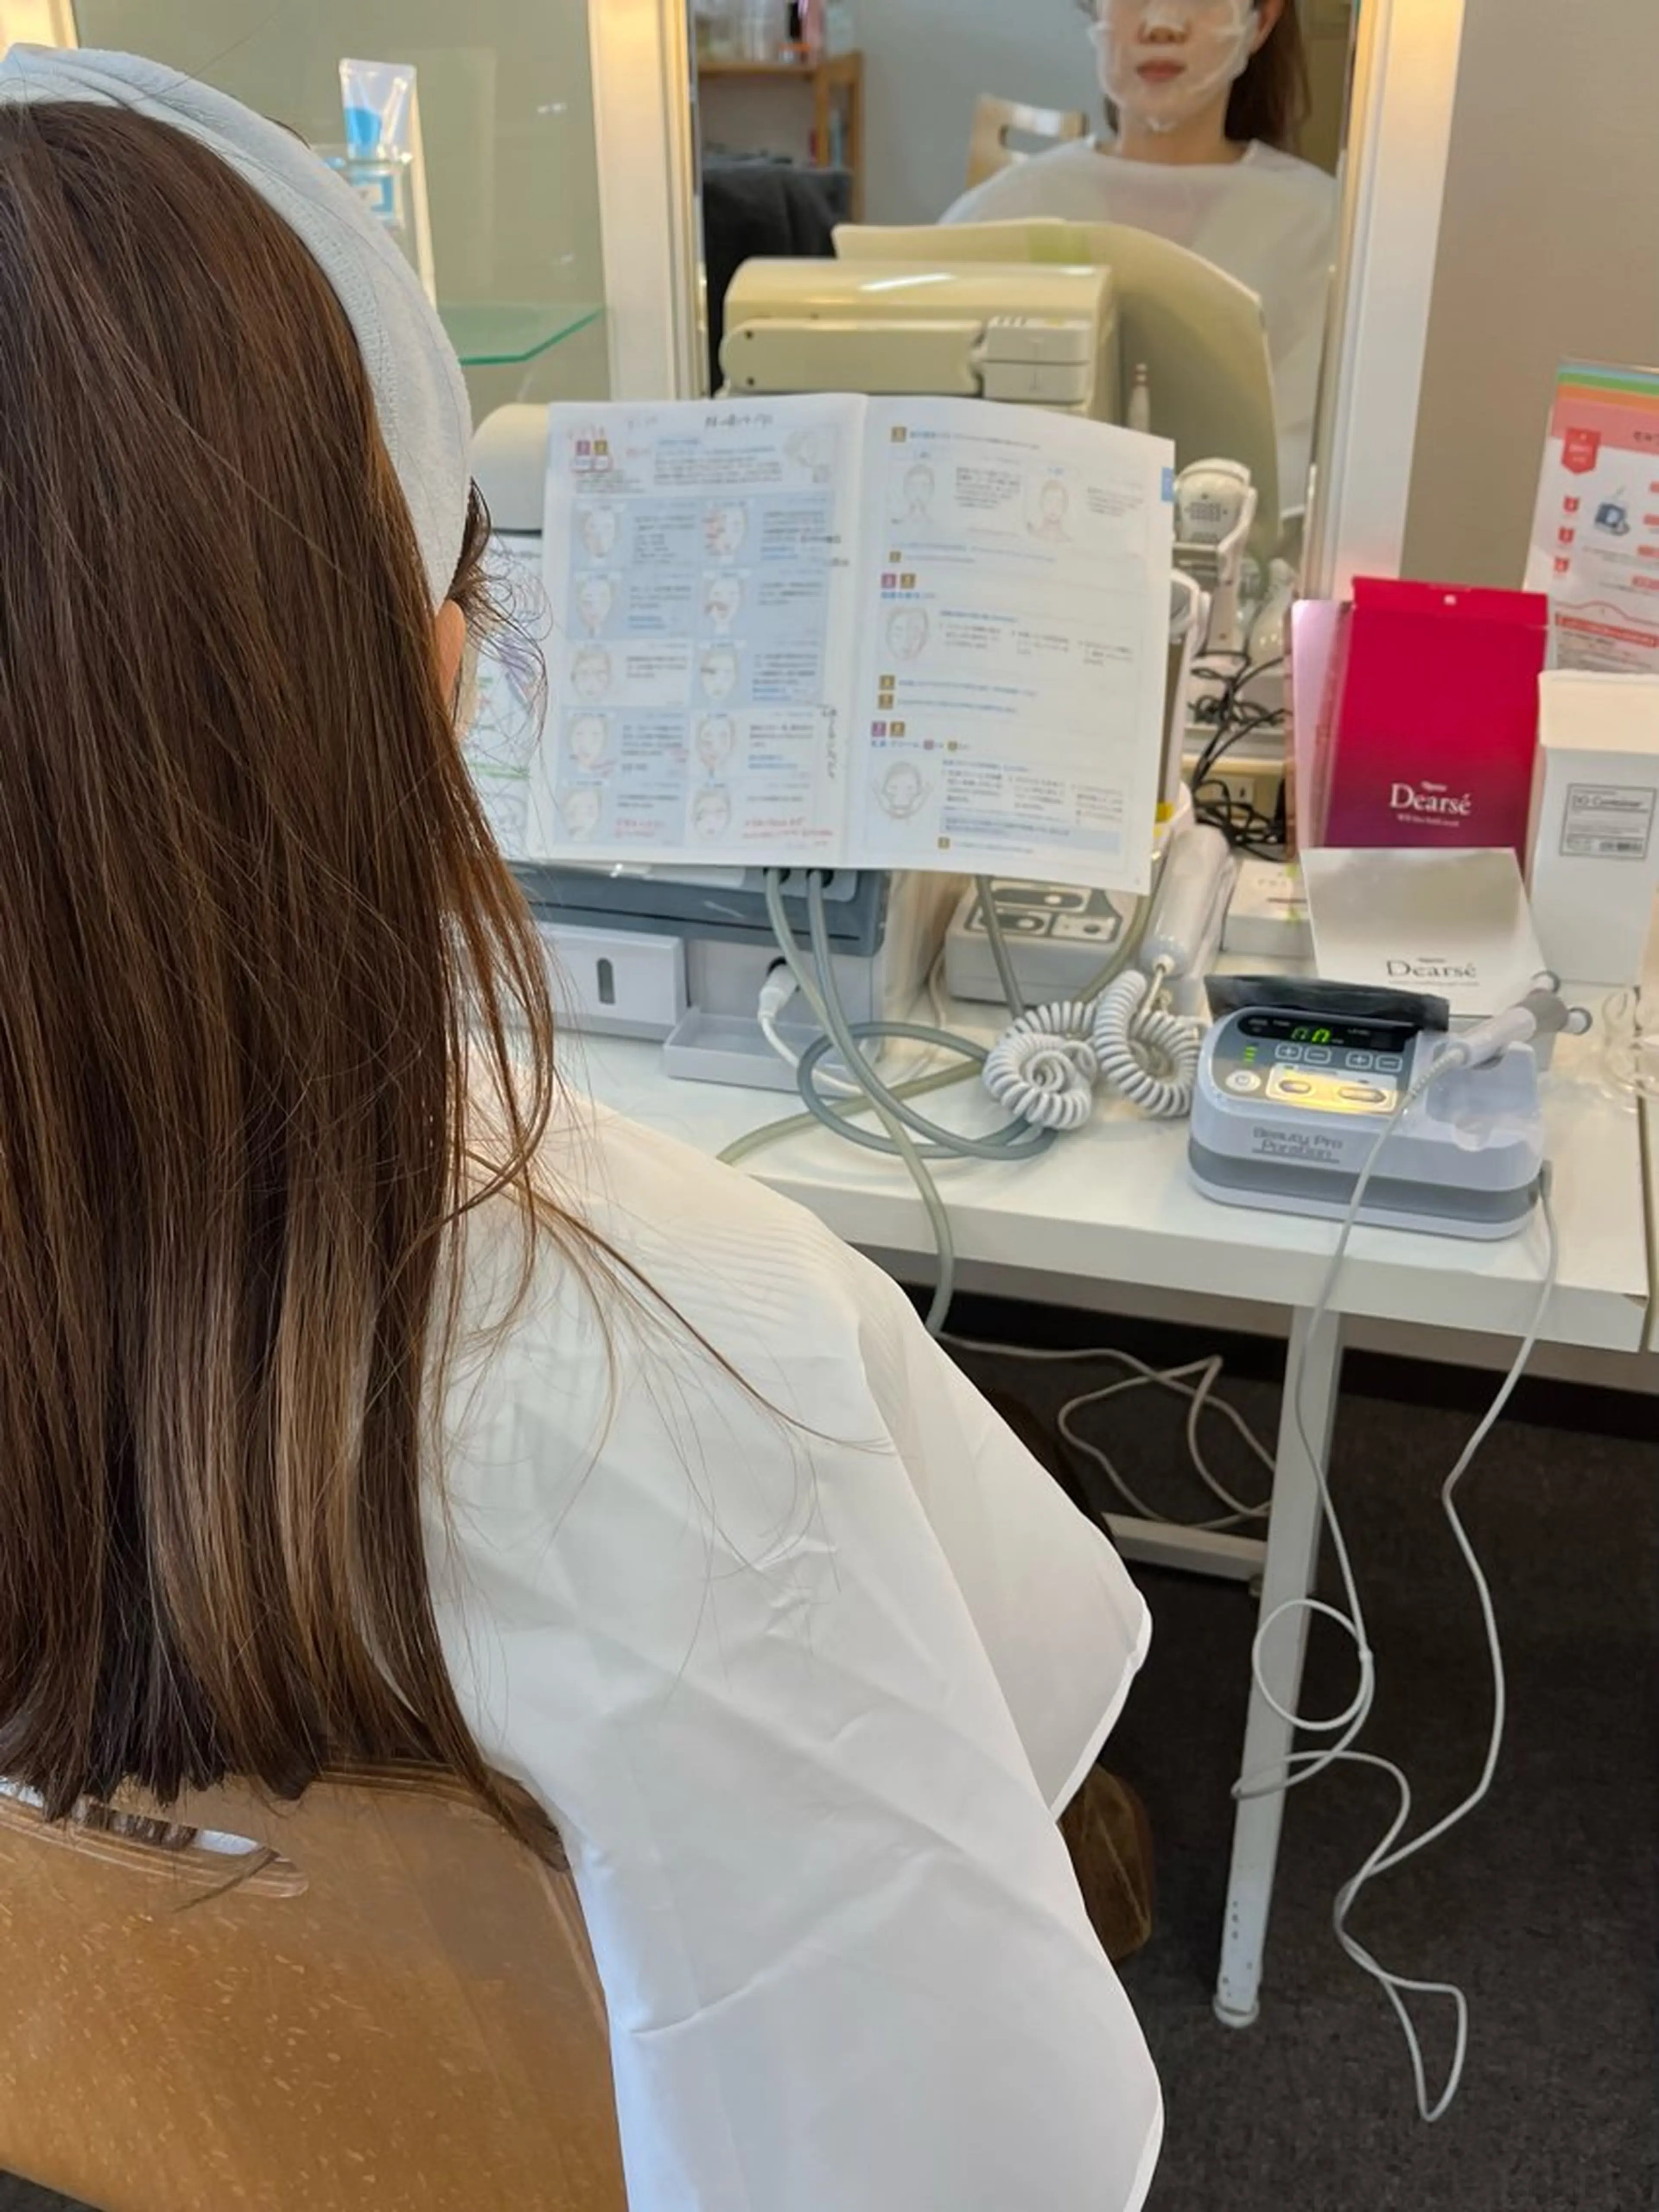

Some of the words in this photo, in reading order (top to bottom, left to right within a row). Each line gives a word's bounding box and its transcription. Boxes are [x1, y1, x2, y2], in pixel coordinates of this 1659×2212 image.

[1390, 782, 1471, 816] Dearsé
[1386, 959, 1476, 978] Dearsé
[1314, 1135, 1343, 1149] Pro
